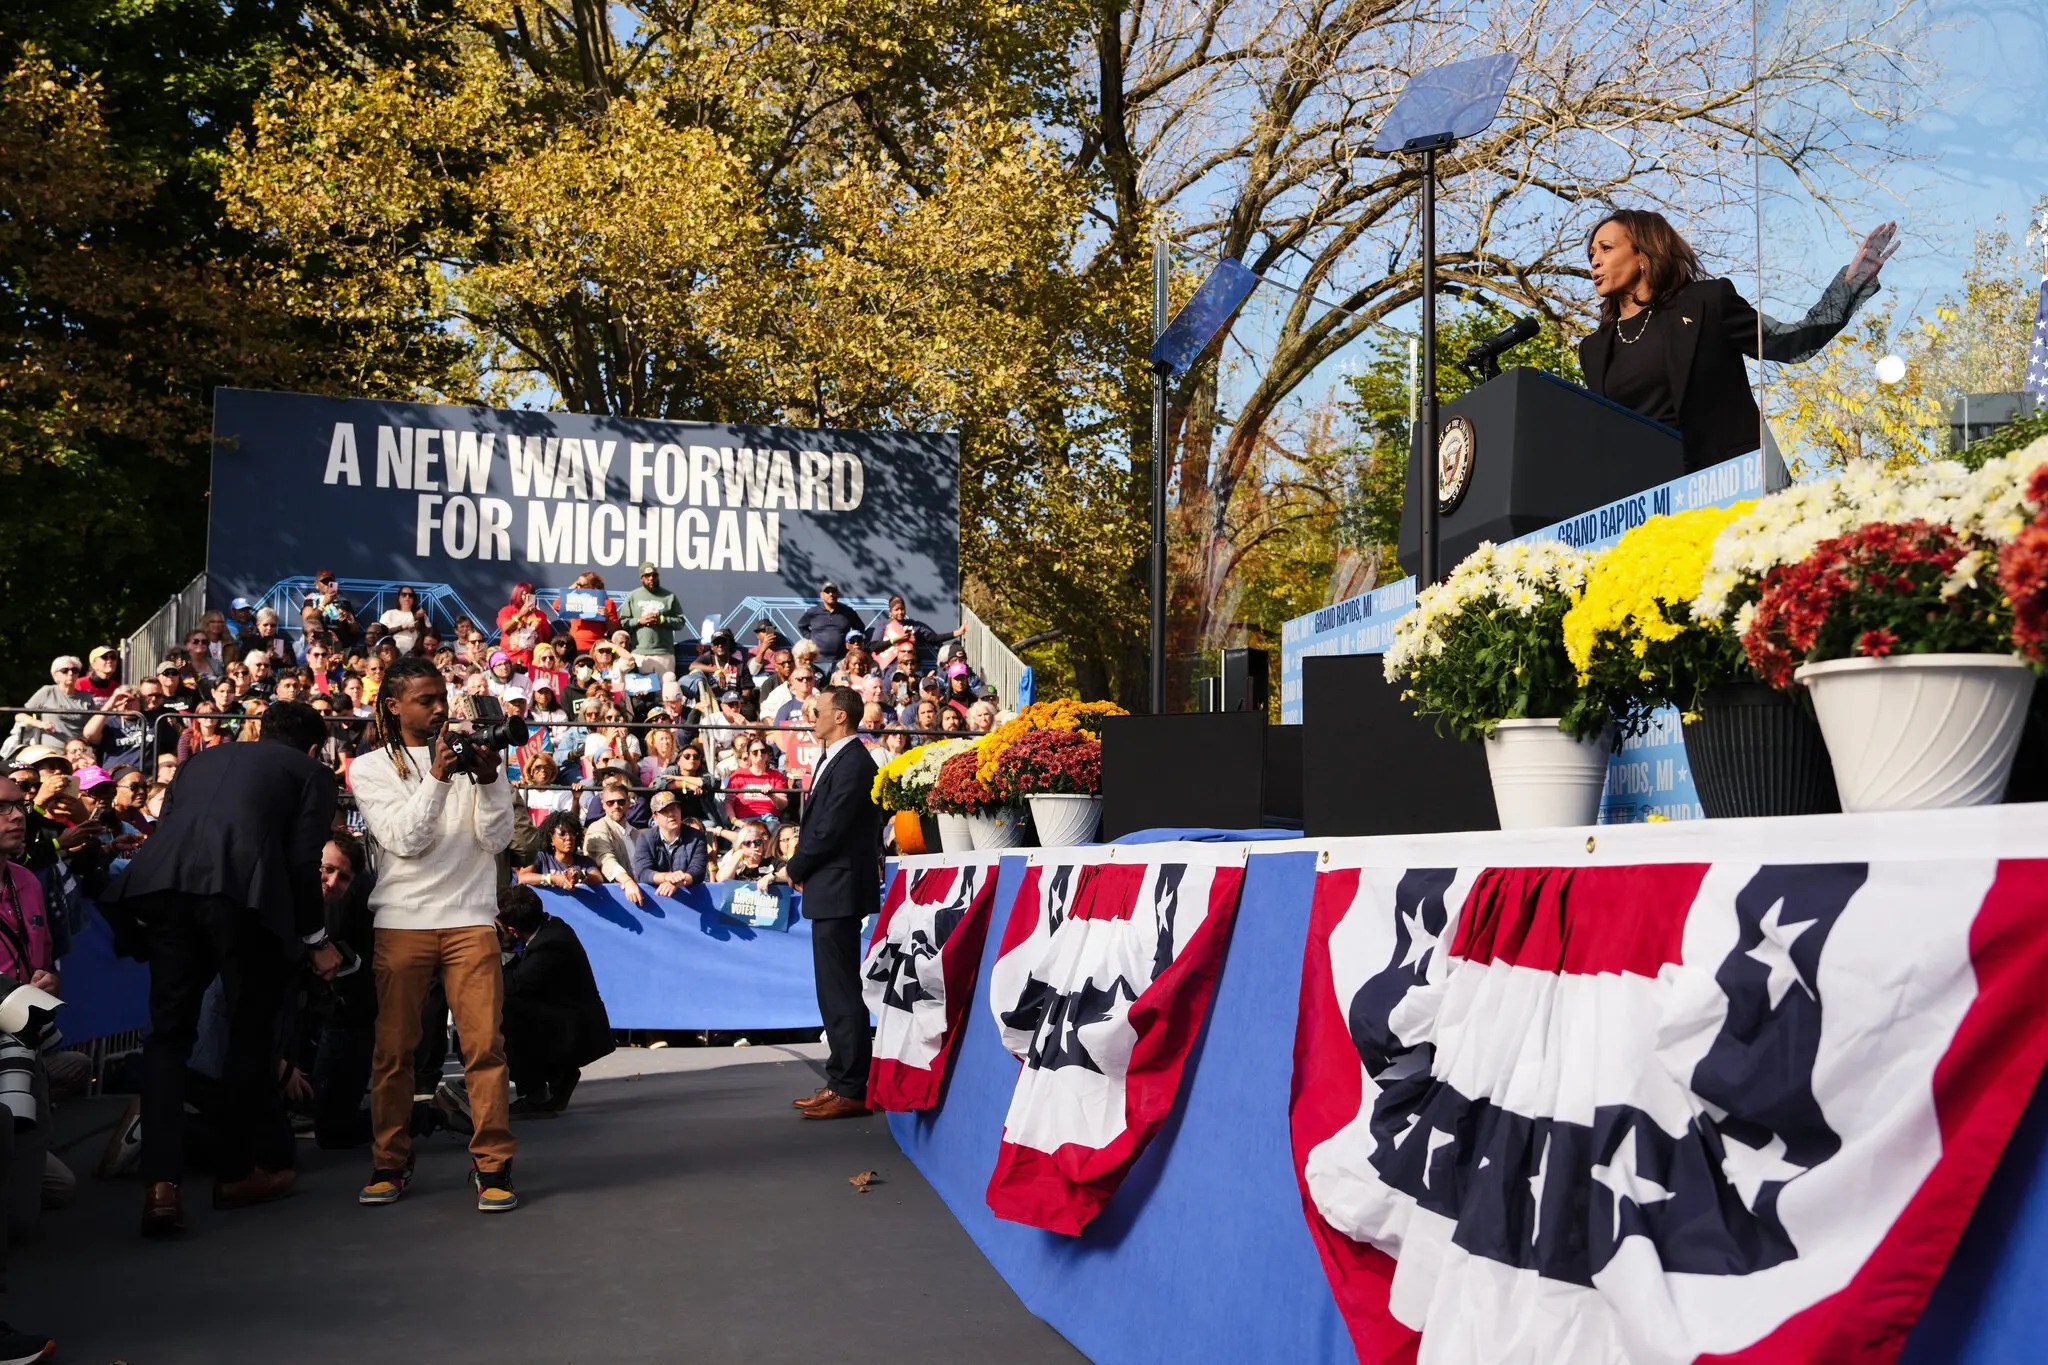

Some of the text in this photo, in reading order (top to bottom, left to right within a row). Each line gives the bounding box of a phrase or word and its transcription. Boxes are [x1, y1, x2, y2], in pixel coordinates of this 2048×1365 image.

[323, 422, 864, 511] A NEW WAY FORWARD
[1558, 516, 1597, 548] GRAND
[1653, 487, 1670, 516] MI
[1688, 463, 1739, 509] GRAND
[416, 493, 780, 573] FOR MICHIGAN
[1315, 608, 1336, 634] GRAND
[1336, 598, 1362, 623] RAPIDS,
[1363, 594, 1372, 618] MI
[1380, 582, 1407, 612] GRAND
[1356, 625, 1379, 652] GRAND
[535, 669, 560, 695] USA
[1656, 759, 1673, 791] MI
[731, 903, 756, 916] VOTES
